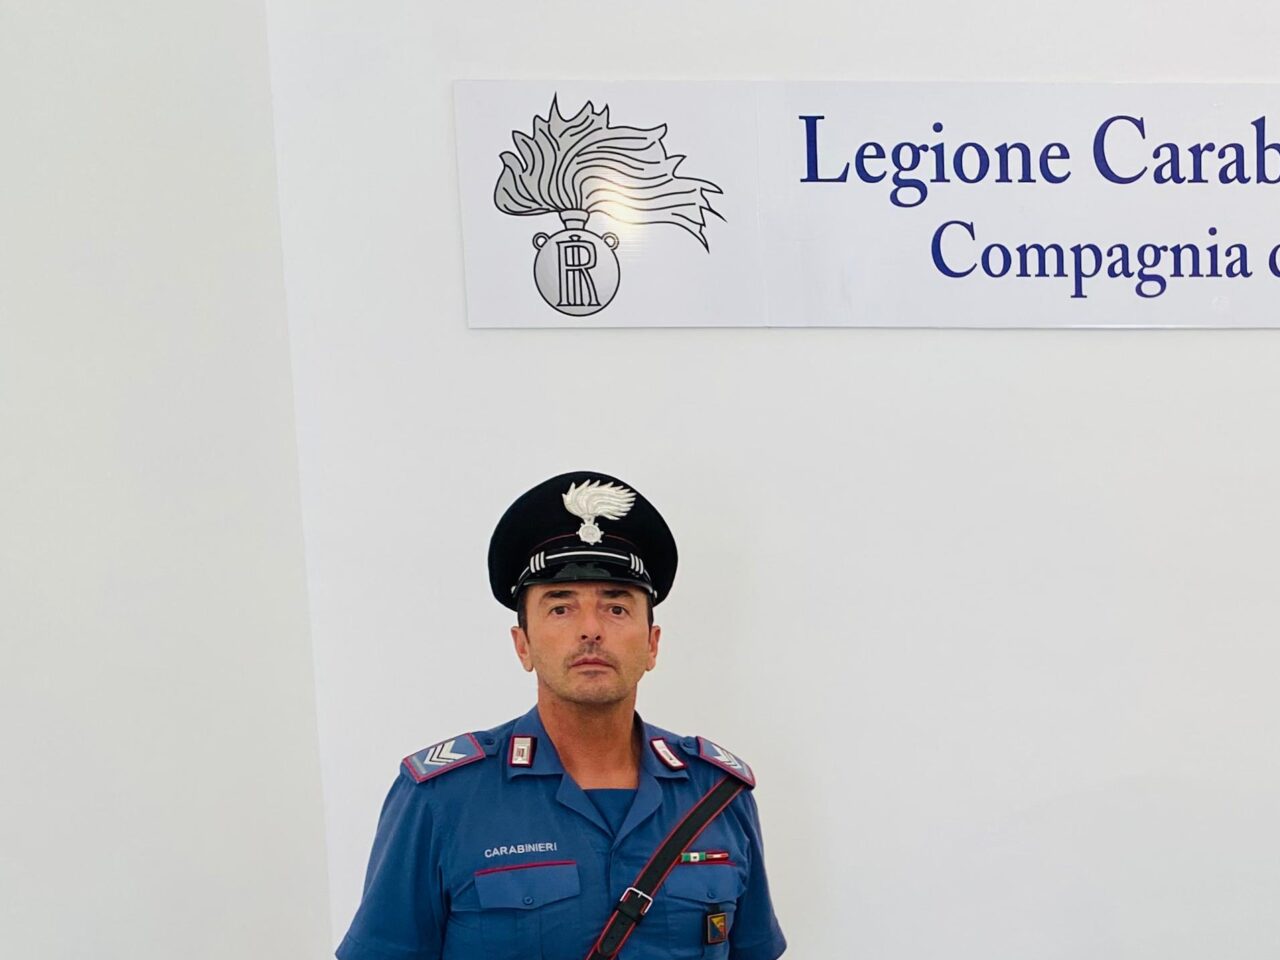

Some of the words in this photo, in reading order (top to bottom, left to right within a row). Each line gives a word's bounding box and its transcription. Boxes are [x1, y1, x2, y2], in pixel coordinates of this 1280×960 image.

[799, 115, 1072, 209] Legione
[930, 220, 1252, 299] Compagnia
[484, 842, 557, 858] CARABINIERI
